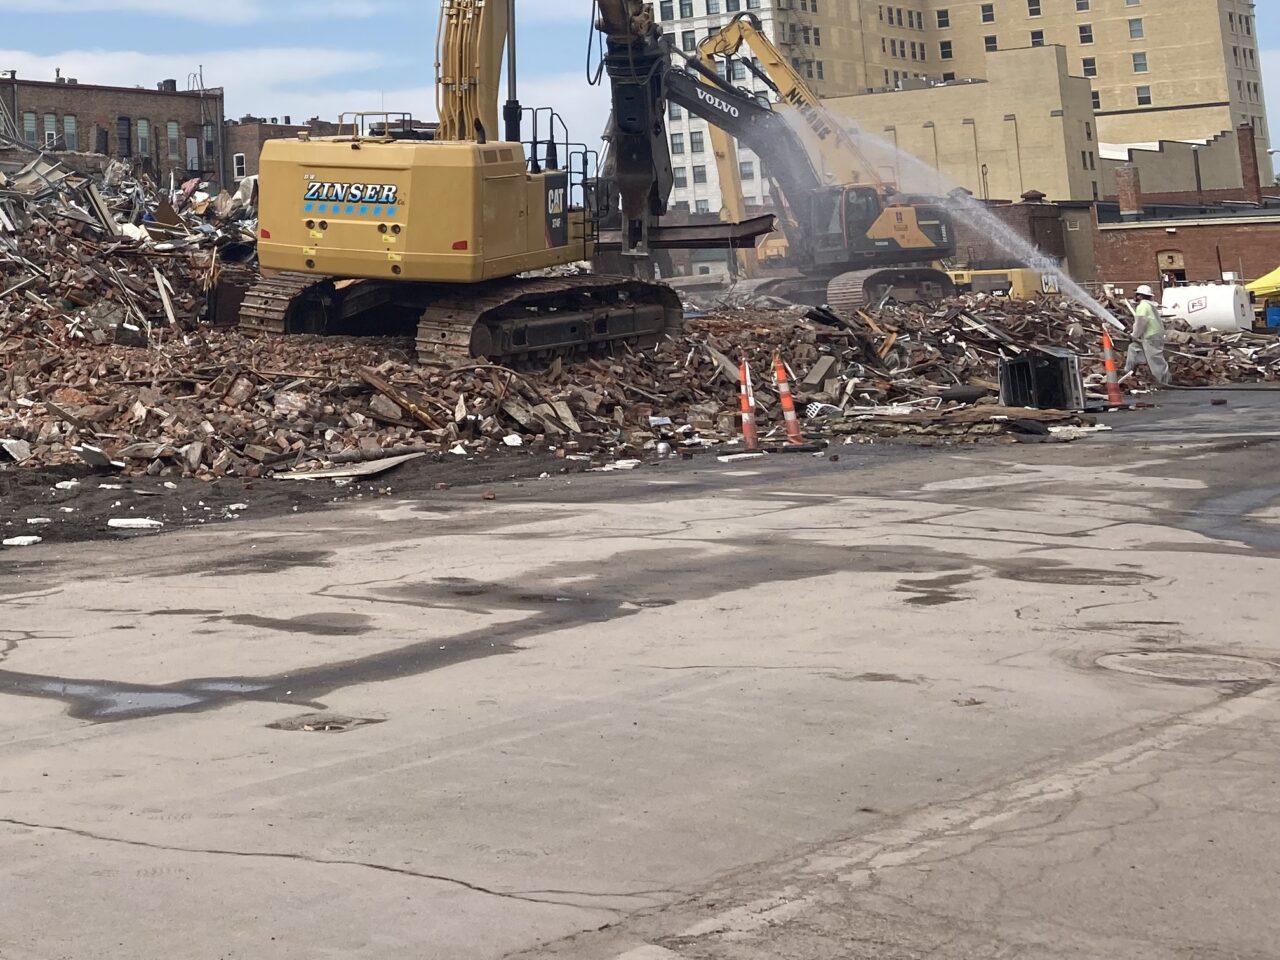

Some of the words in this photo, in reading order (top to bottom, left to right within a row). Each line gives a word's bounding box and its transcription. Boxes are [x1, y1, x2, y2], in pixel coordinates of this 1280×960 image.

[695, 87, 739, 118] VOLVO
[304, 181, 398, 204] ZINSER
[548, 188, 564, 214] CAT
[1041, 274, 1059, 294] CAT
